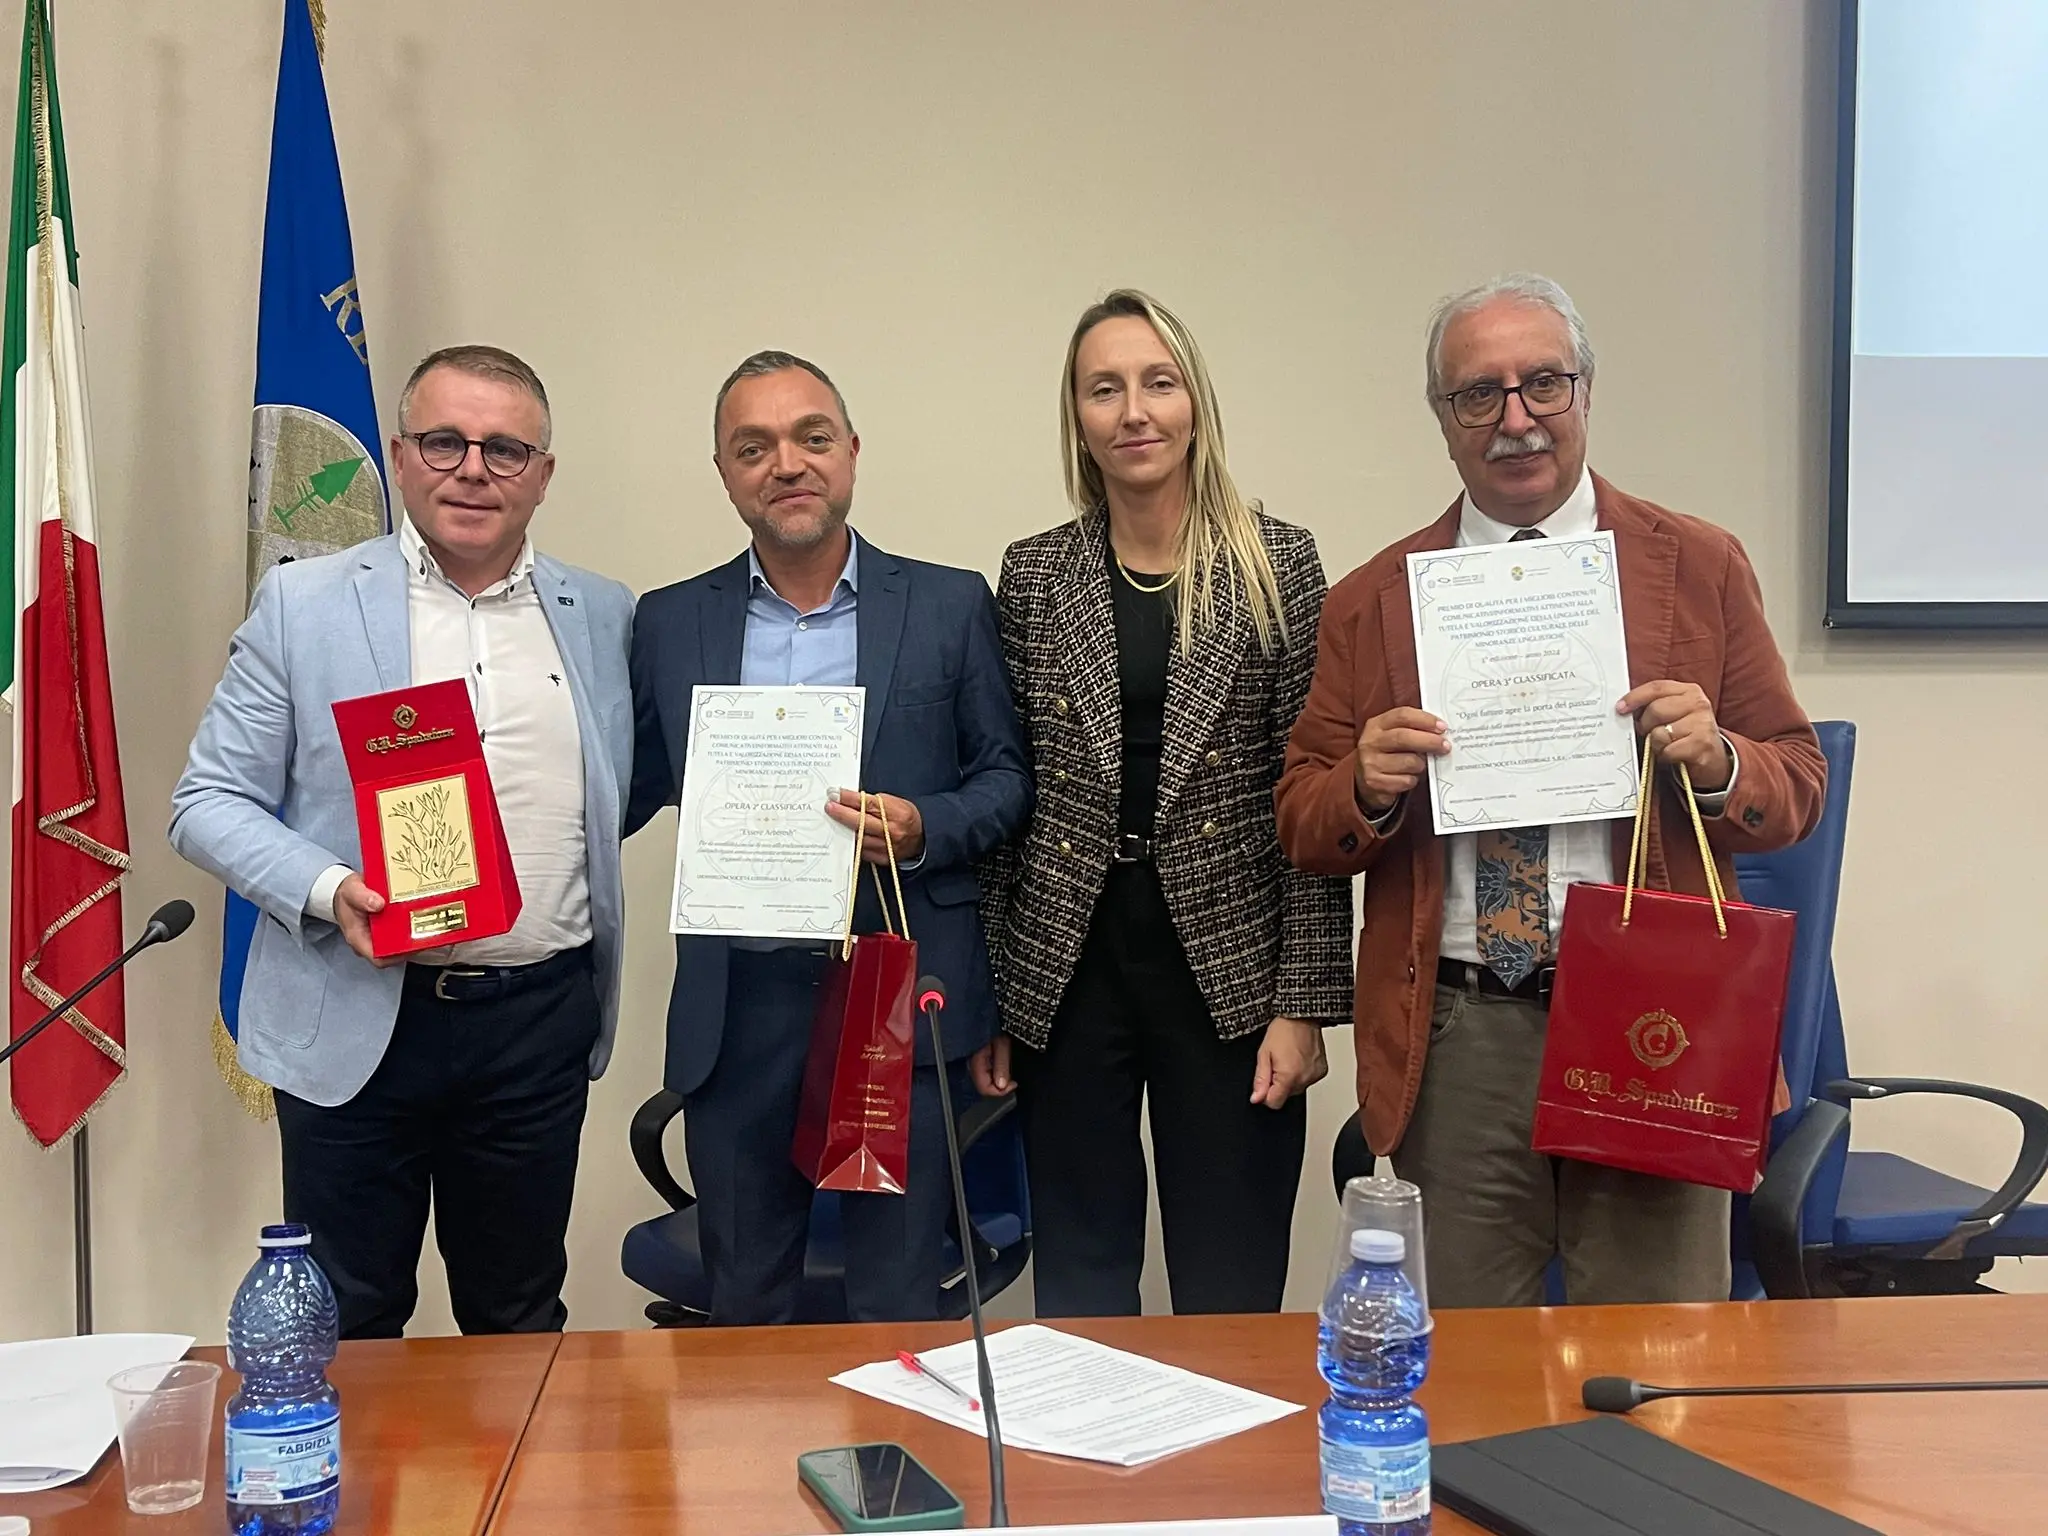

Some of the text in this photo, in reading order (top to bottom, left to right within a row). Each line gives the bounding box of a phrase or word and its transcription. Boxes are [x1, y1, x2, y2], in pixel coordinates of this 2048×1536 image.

[1437, 603, 1464, 612] PREMIO
[1556, 588, 1596, 598] CONTENUTI
[1438, 623, 1464, 631] TUTELA
[1471, 678, 1501, 689] OPERA
[1512, 670, 1576, 685] CLASSIFICATA
[1504, 705, 1522, 715] apre
[1532, 702, 1553, 712] porta
[724, 802, 750, 810] OPERA
[760, 802, 812, 811] CLASSIFICATA
[278, 1436, 331, 1455] FABRIZIA
